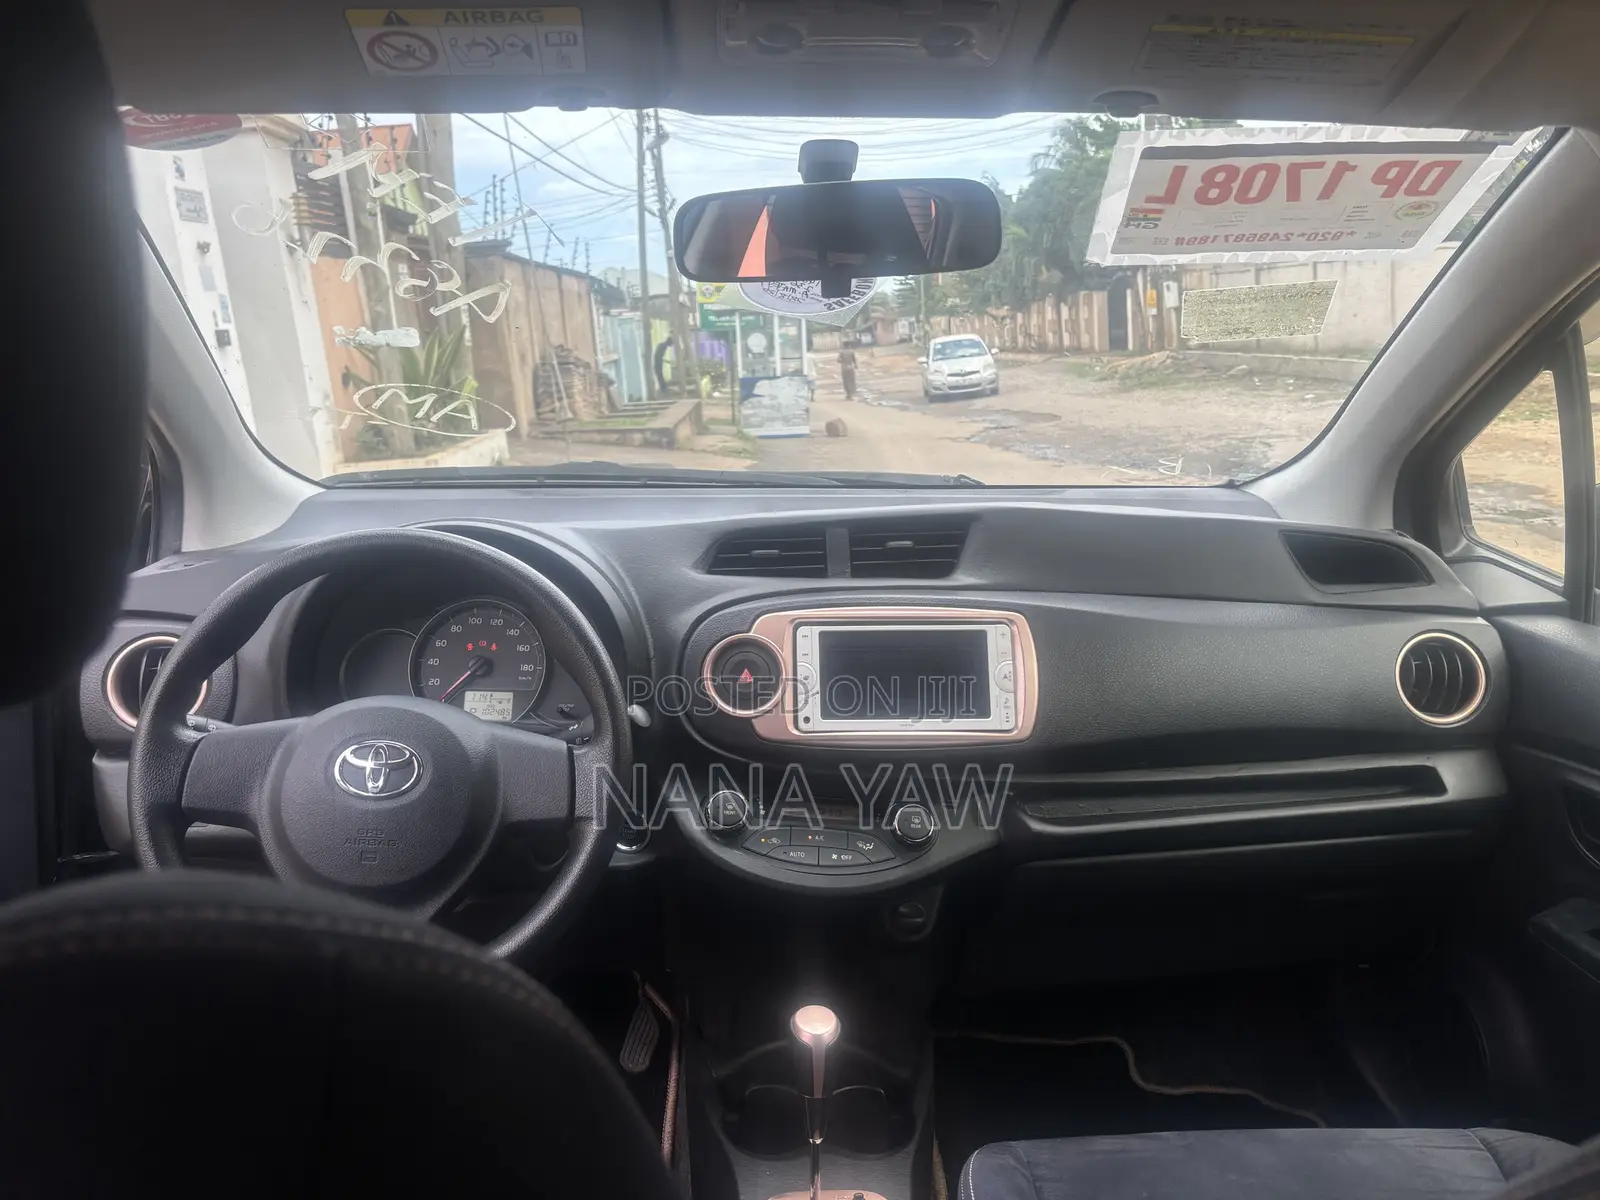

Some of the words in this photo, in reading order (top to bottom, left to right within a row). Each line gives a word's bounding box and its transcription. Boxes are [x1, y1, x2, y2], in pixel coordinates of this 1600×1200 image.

[443, 10, 545, 25] AIRBAG
[467, 616, 483, 625] 100
[489, 617, 504, 626] 120
[450, 624, 463, 633] 80
[505, 628, 520, 637] 140
[435, 639, 447, 647] 60
[516, 643, 530, 652] 160
[427, 657, 440, 666] 40
[520, 663, 534, 672] 180
[428, 677, 440, 686] 20
